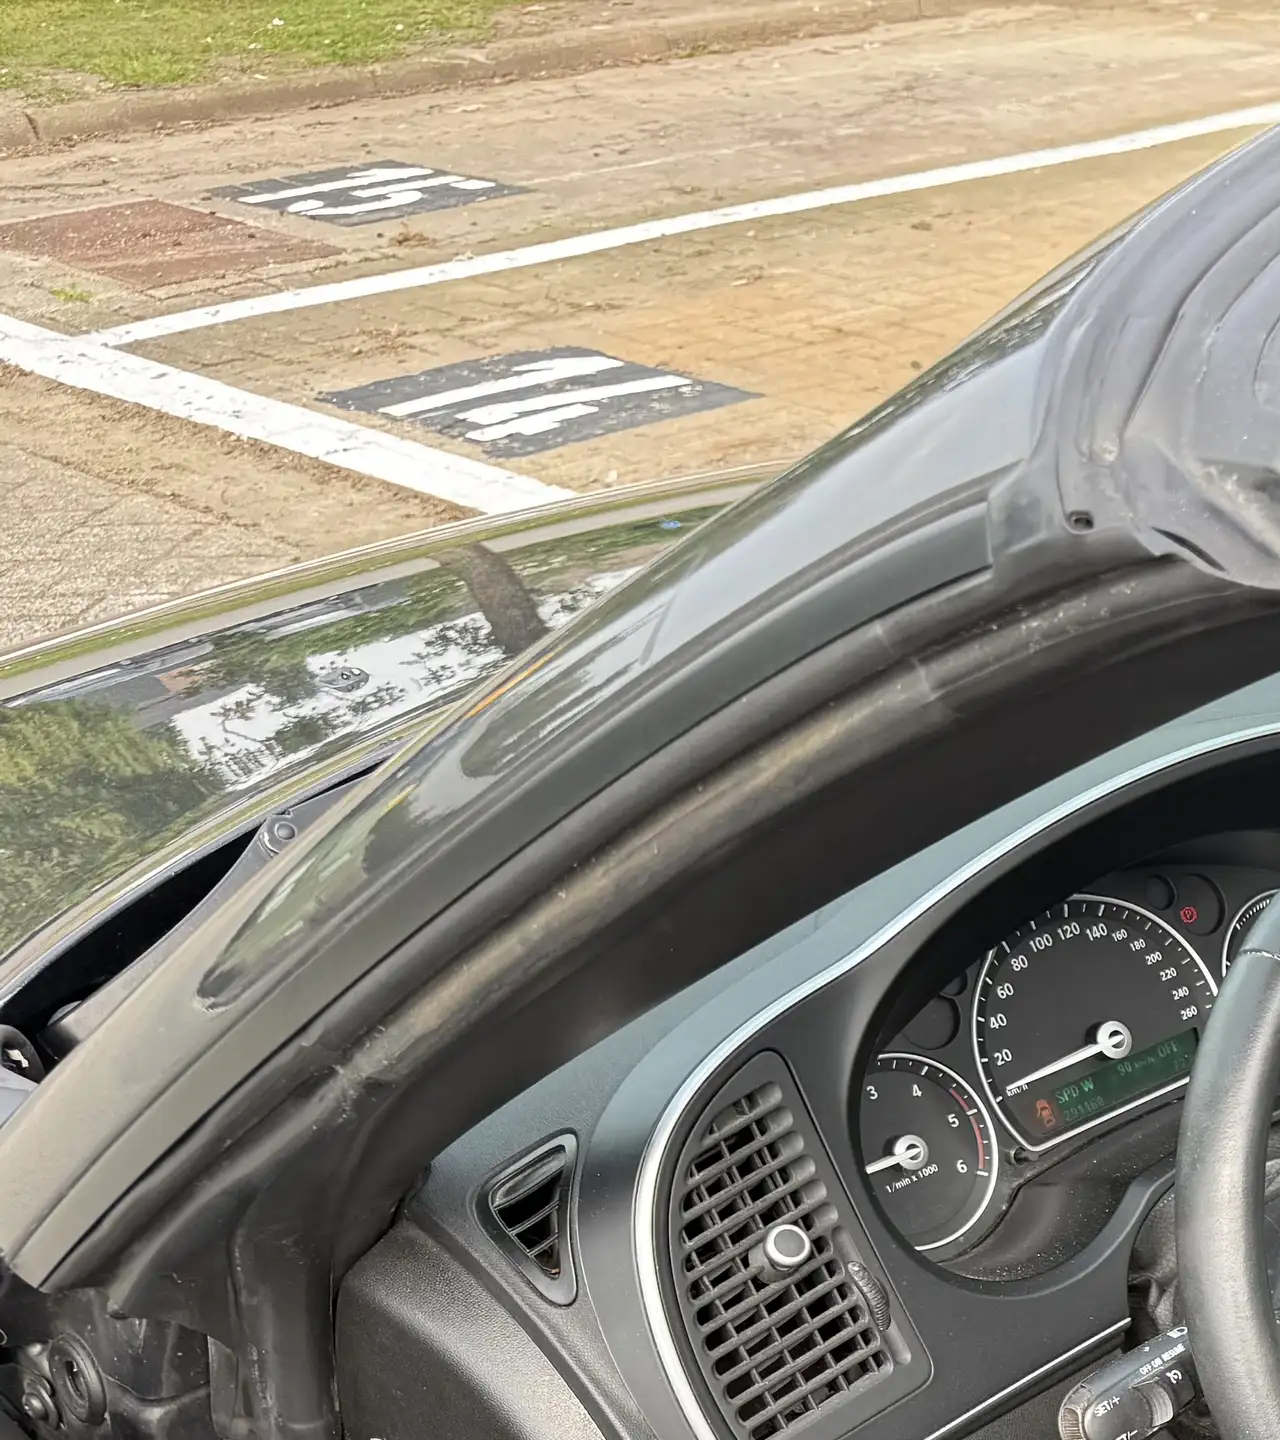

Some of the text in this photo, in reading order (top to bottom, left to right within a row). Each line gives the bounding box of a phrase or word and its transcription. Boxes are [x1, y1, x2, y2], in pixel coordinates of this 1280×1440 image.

[237, 166, 497, 217] 15
[1056, 921, 1080, 940] 120
[1085, 922, 1108, 941] 140
[1111, 928, 1128, 942] 160
[1028, 933, 1053, 953] 100
[1129, 938, 1146, 952] 180
[1010, 954, 1029, 972] 80
[1145, 951, 1163, 965] 200
[1159, 967, 1177, 981] 220
[996, 982, 1014, 999] 60
[1172, 986, 1190, 1001] 240
[1180, 1005, 1198, 1020] 260
[989, 1013, 1007, 1030] 40
[993, 1048, 1013, 1066] 20
[1054, 1084, 1080, 1105] SPD
[1080, 1076, 1096, 1092] W
[1156, 1040, 1180, 1059] OFF
[866, 1085, 879, 1100] 3
[912, 1083, 923, 1098] 4
[947, 1113, 960, 1128] 5
[956, 1159, 968, 1174] 6
[885, 1174, 912, 1194] 1/min
[918, 1163, 939, 1178] 1000
[1139, 1362, 1153, 1376] OFF
[1093, 1395, 1121, 1418] SET/+
